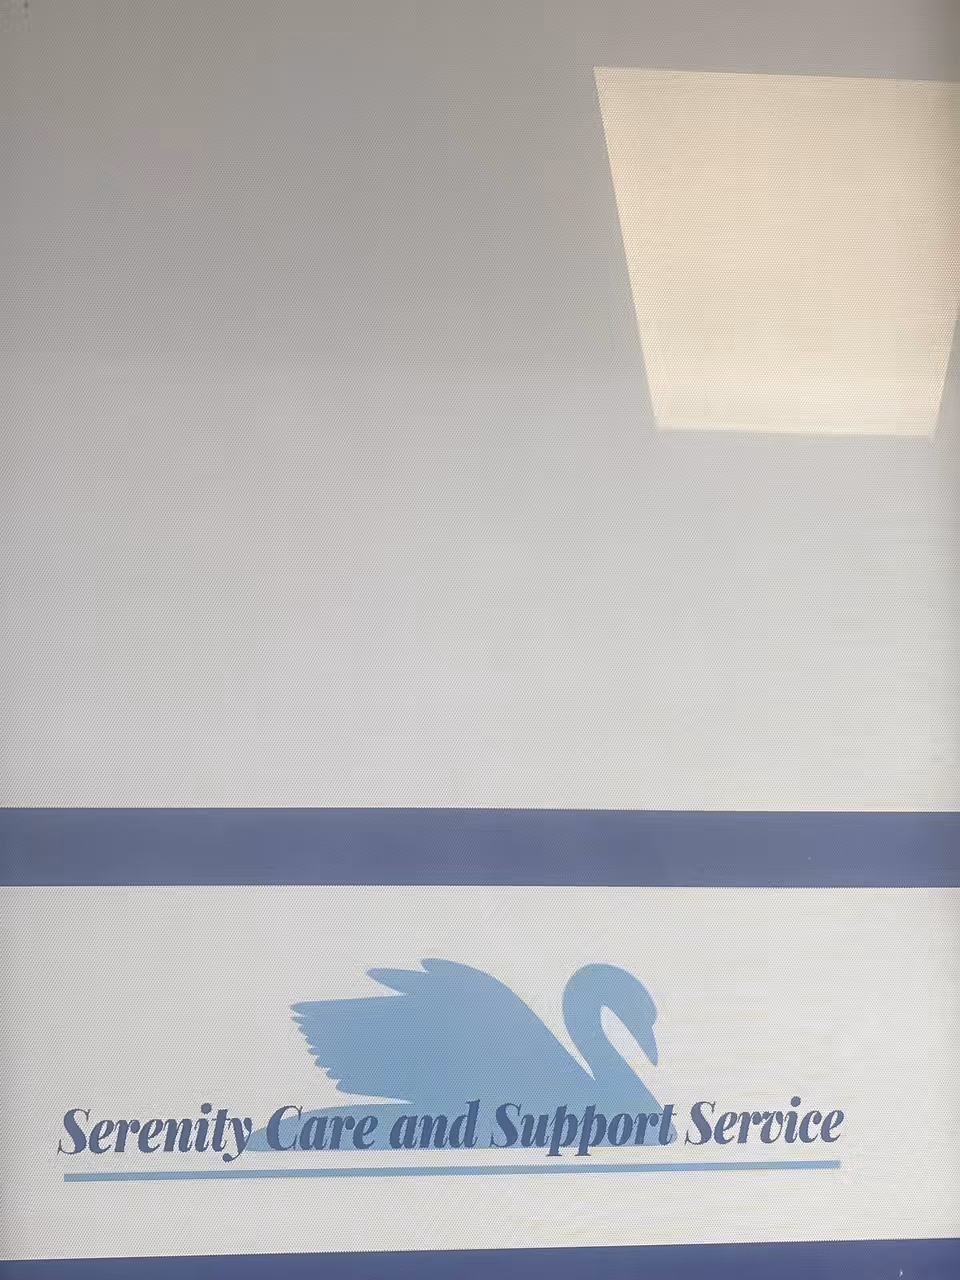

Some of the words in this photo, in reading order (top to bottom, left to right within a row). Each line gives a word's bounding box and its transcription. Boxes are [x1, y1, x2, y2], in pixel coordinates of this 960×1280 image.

[57, 1102, 253, 1162] Serenity
[266, 1105, 379, 1151] Care
[389, 1099, 481, 1150] and
[490, 1100, 677, 1157] Support
[685, 1095, 845, 1146] Service
